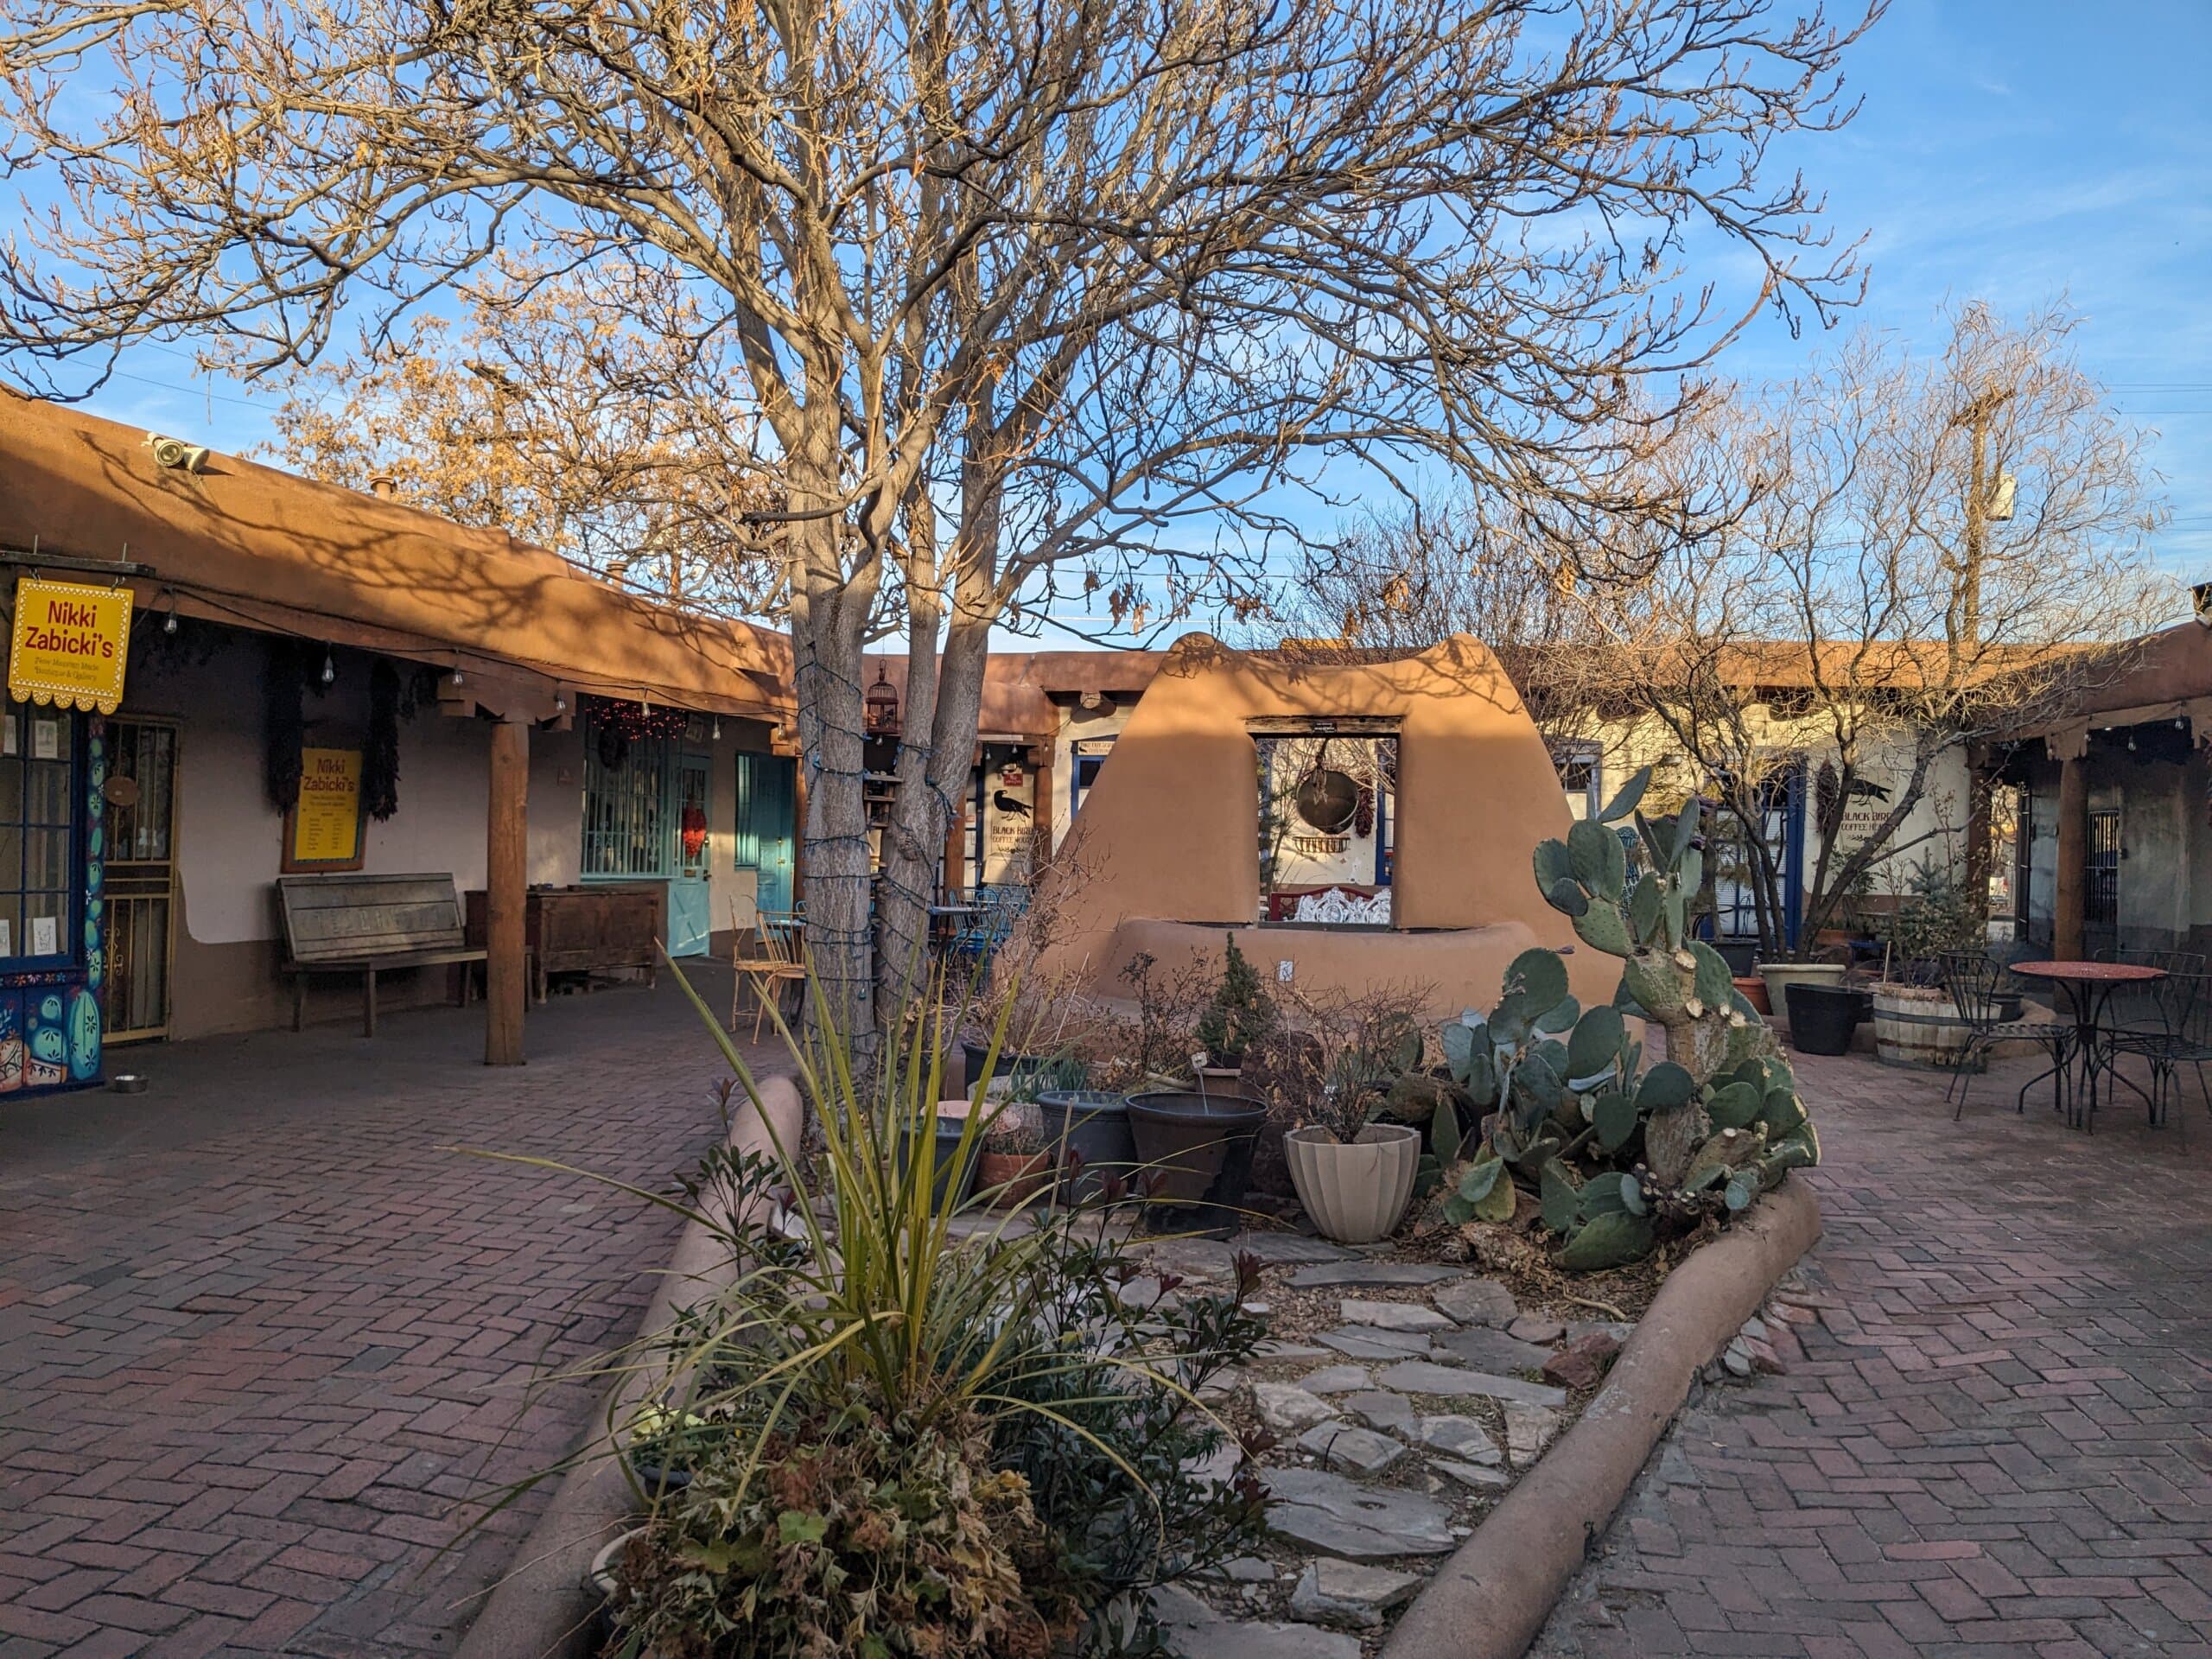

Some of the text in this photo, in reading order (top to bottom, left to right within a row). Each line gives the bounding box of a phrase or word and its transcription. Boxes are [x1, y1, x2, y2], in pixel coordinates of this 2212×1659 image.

[48, 600, 98, 628] Nikki
[25, 626, 114, 658] Zabicki's
[317, 759, 345, 774] Nikki
[304, 777, 355, 792] Zabicki's
[993, 825, 1014, 835] BLACK
